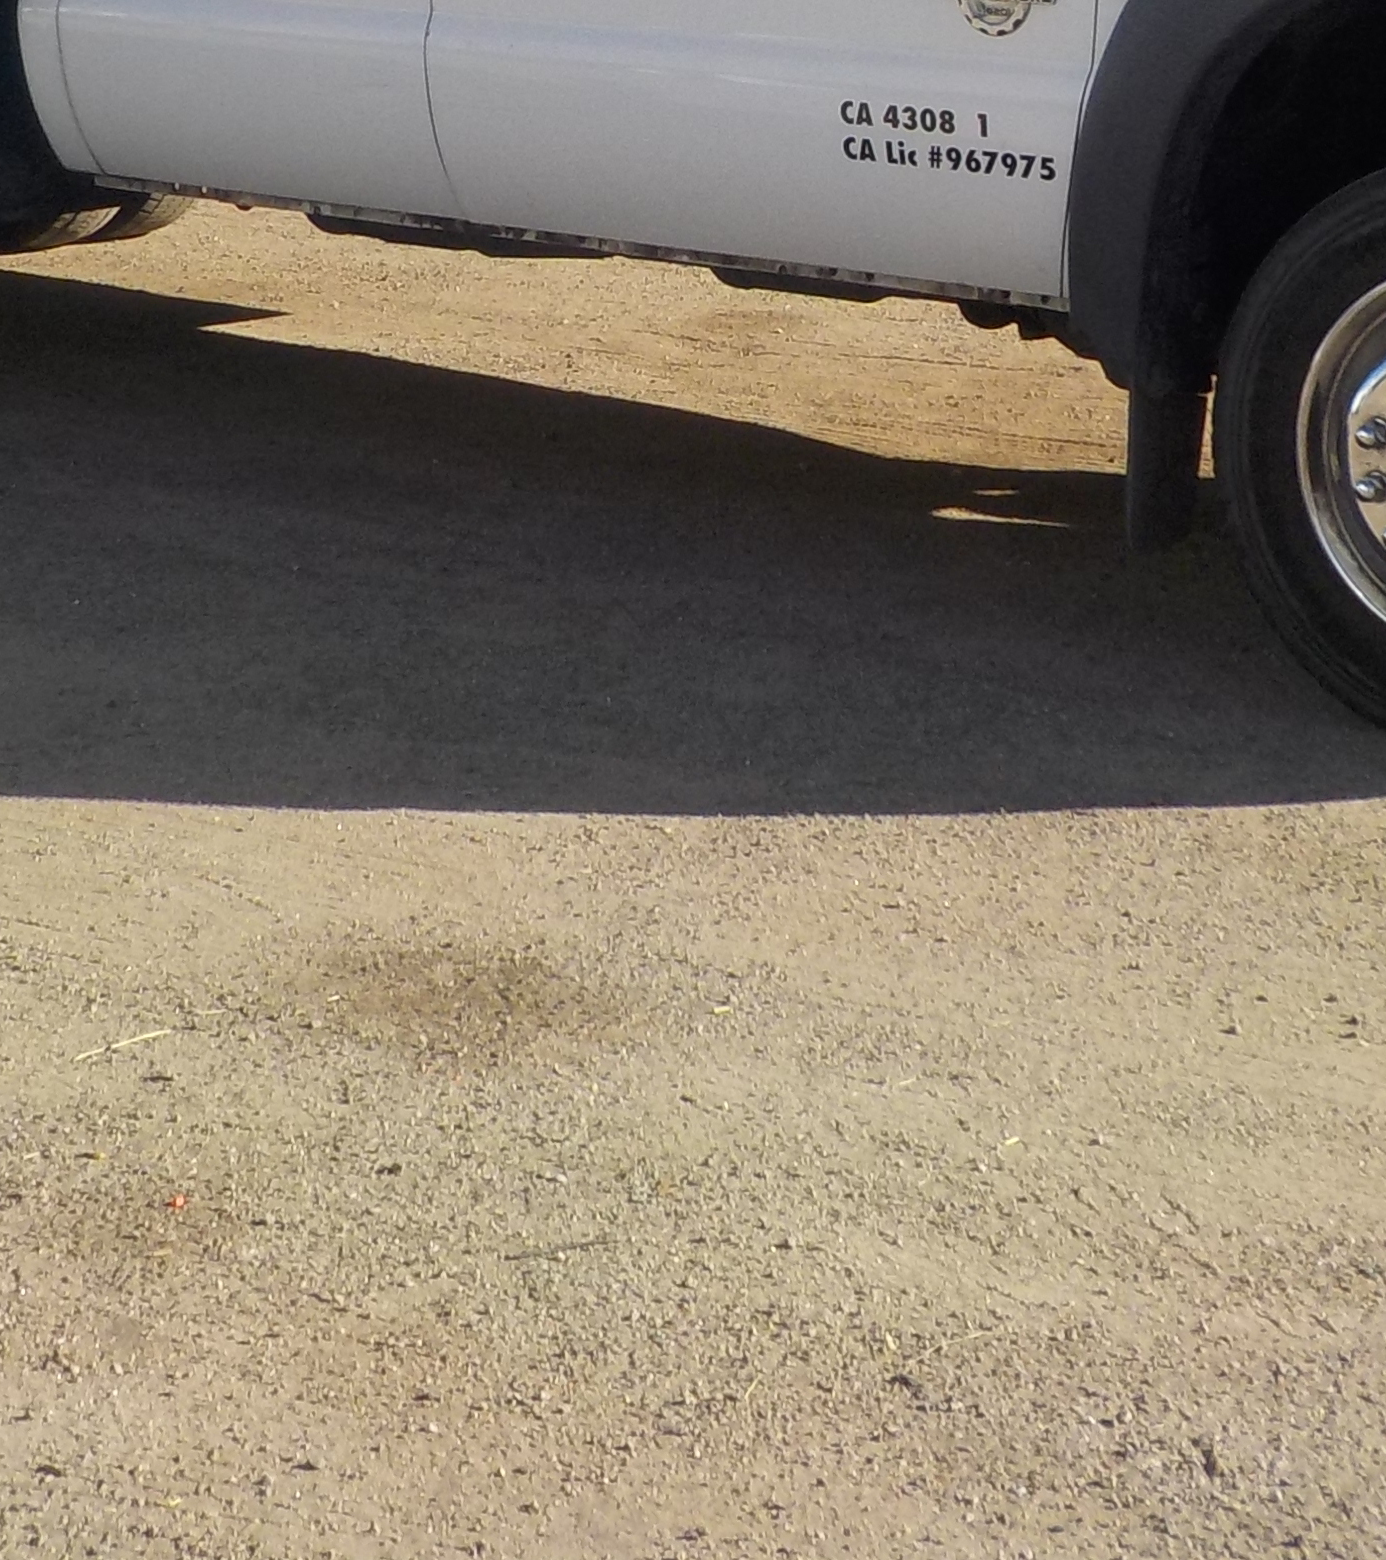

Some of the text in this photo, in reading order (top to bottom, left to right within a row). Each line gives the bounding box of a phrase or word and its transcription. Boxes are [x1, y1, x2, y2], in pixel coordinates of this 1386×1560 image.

[840, 100, 989, 138] CA 4308 1
[843, 136, 877, 162] CA
[927, 144, 1057, 181] #967975
